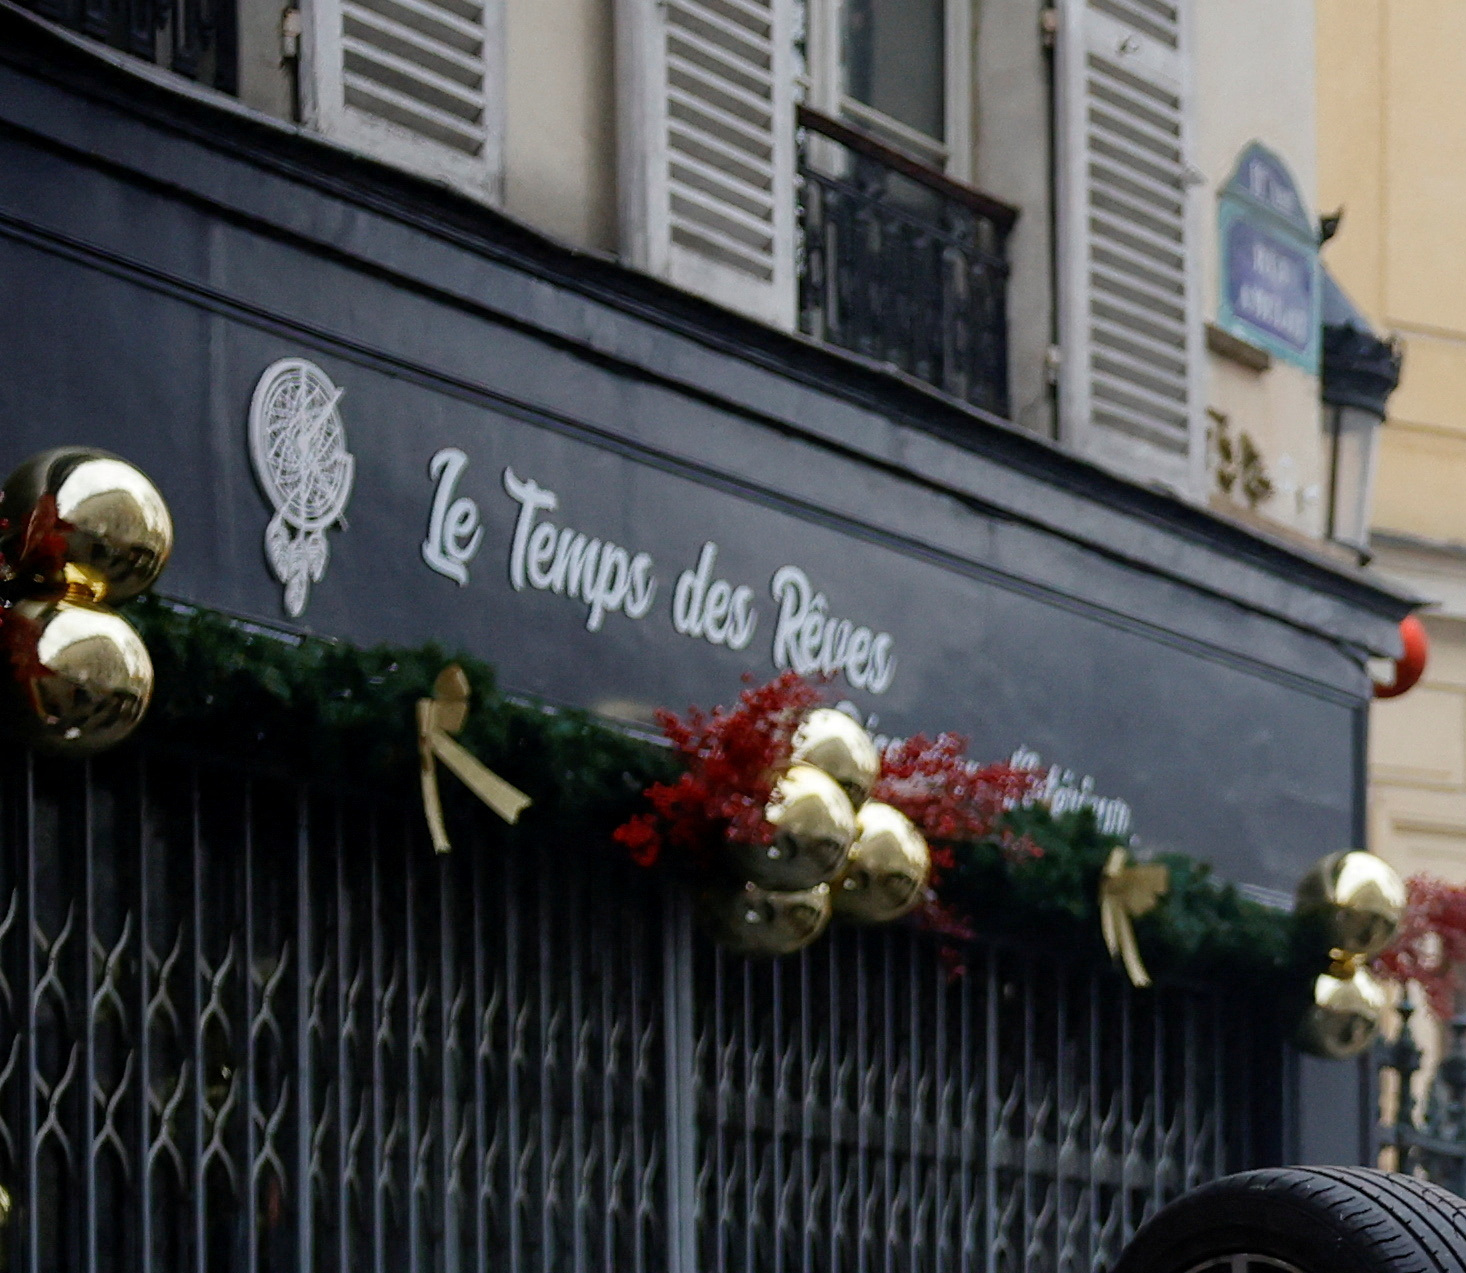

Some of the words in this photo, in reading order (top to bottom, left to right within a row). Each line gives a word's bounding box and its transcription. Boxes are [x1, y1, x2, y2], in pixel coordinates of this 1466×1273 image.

[421, 446, 485, 588] Le
[502, 465, 658, 633] Temps
[672, 540, 758, 650] des
[772, 565, 896, 694] Rêves
